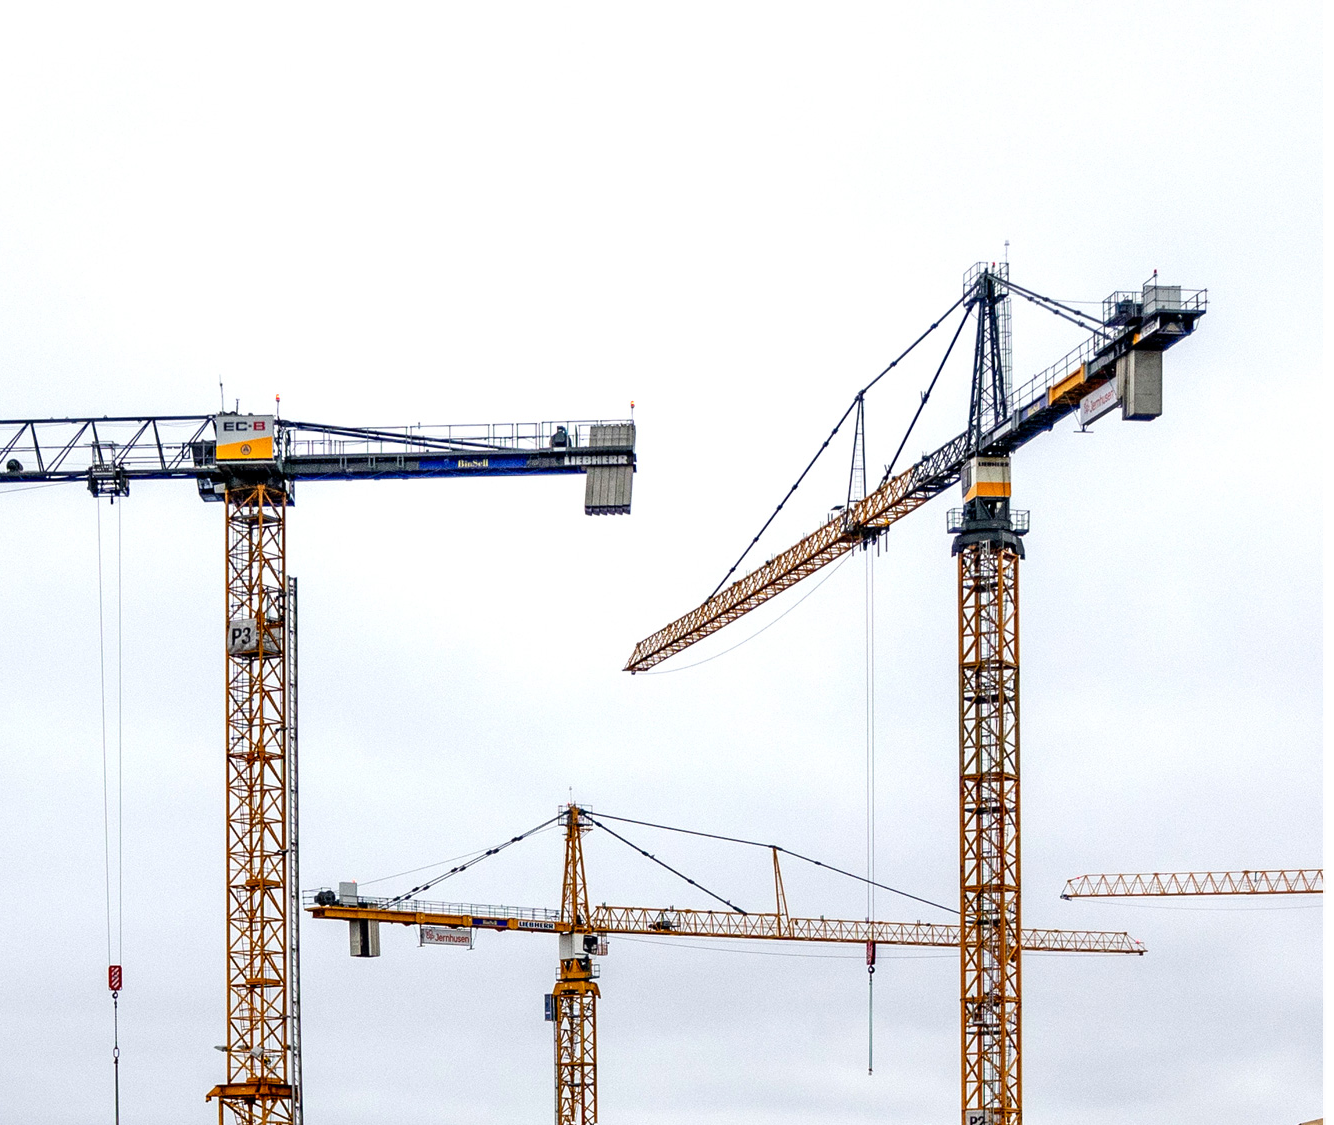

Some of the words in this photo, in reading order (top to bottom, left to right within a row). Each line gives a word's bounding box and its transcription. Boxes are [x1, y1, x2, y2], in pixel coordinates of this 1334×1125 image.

[564, 455, 628, 466] LIEBHERR
[232, 627, 251, 646] P3
[519, 921, 554, 929] LIEBHERR
[435, 933, 470, 943] Jernhusen
